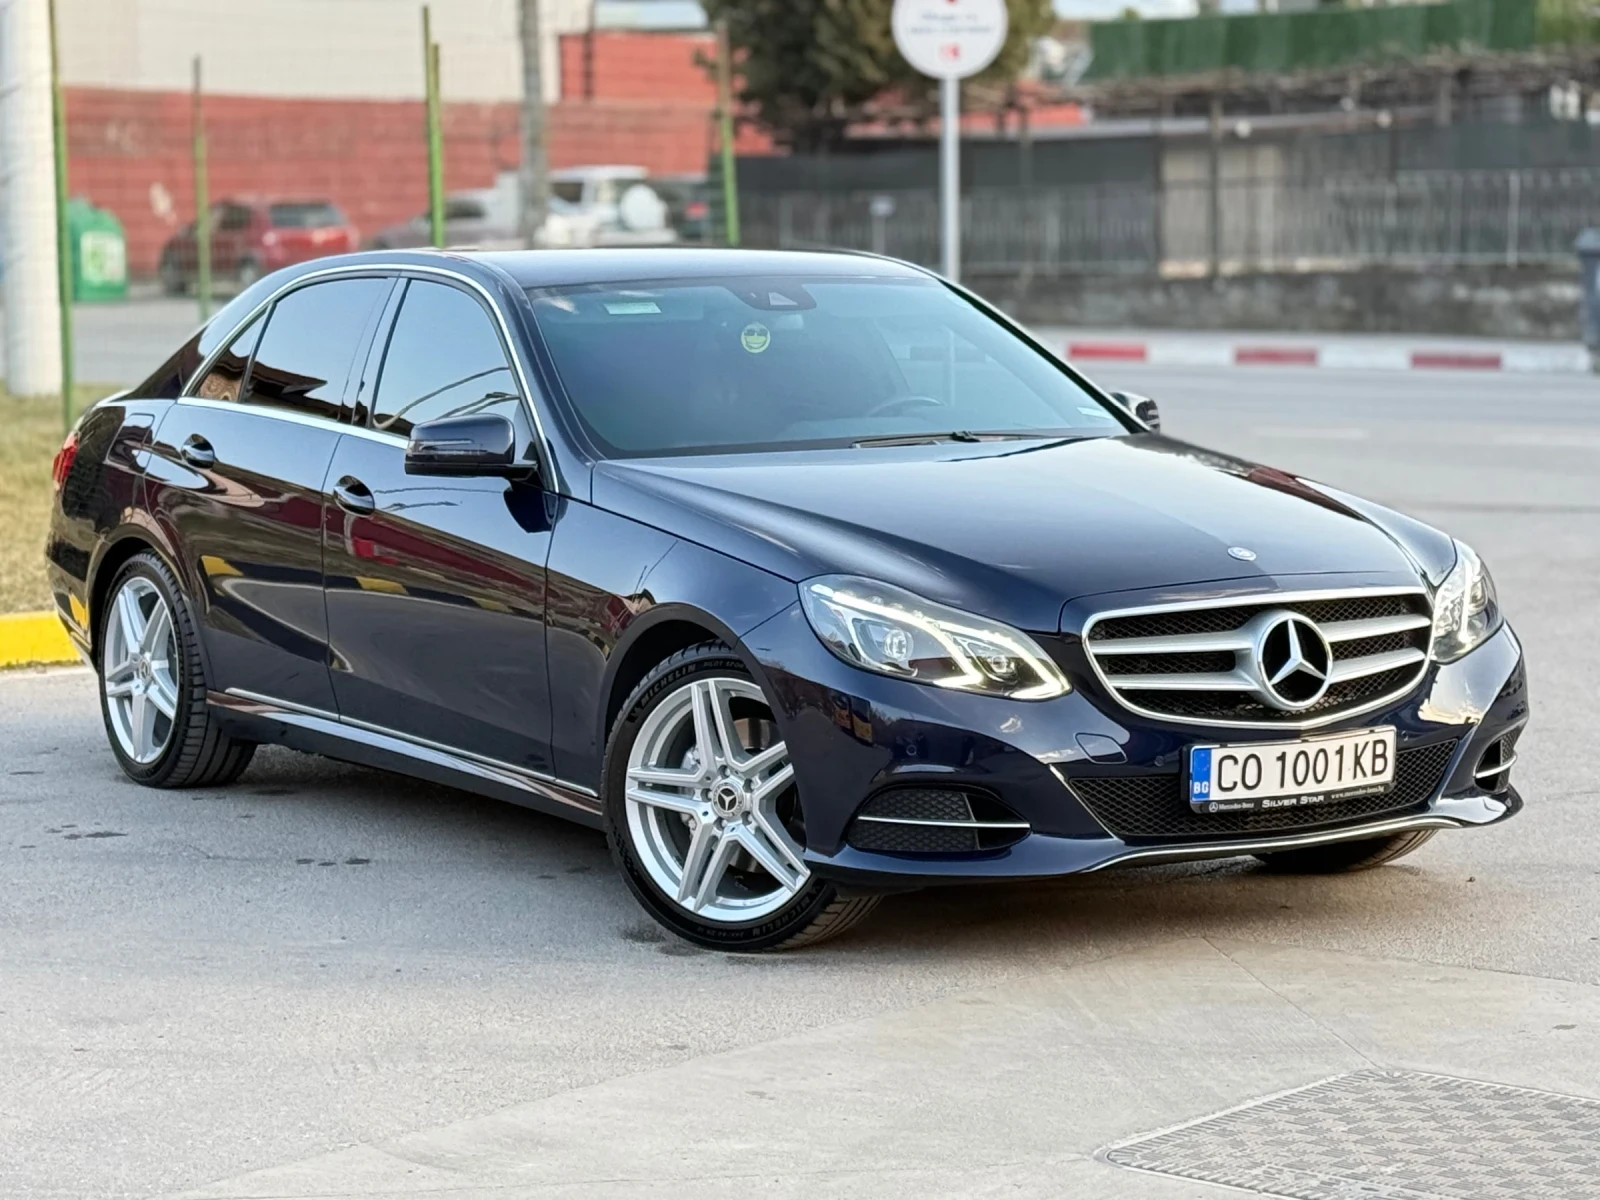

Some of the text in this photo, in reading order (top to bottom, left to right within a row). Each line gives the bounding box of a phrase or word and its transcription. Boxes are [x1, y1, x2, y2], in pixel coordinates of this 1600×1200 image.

[641, 664, 697, 706] MICHELIN
[1193, 781, 1209, 794] BG
[1217, 753, 1262, 793] CO
